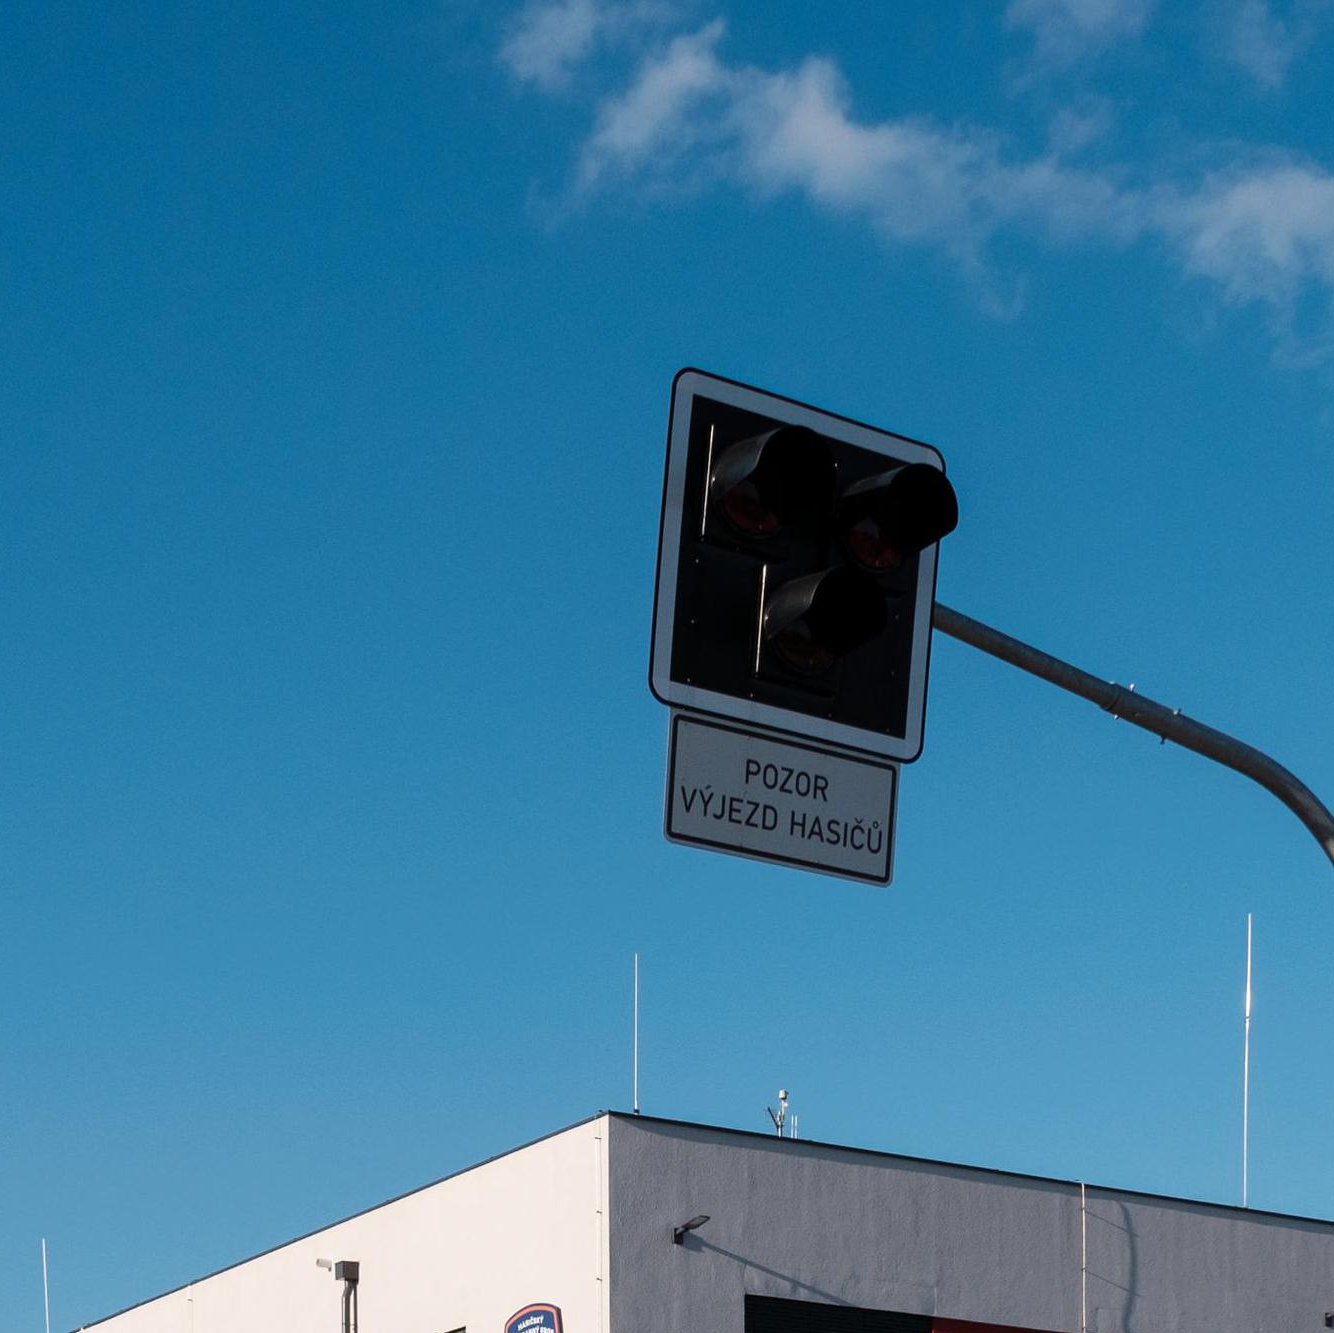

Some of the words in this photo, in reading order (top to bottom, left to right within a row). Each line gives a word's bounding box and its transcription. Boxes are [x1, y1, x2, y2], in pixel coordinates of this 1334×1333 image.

[745, 759, 829, 802] POZOR
[681, 785, 778, 831] VÝJEZD
[789, 811, 882, 854] HASIČŮ
